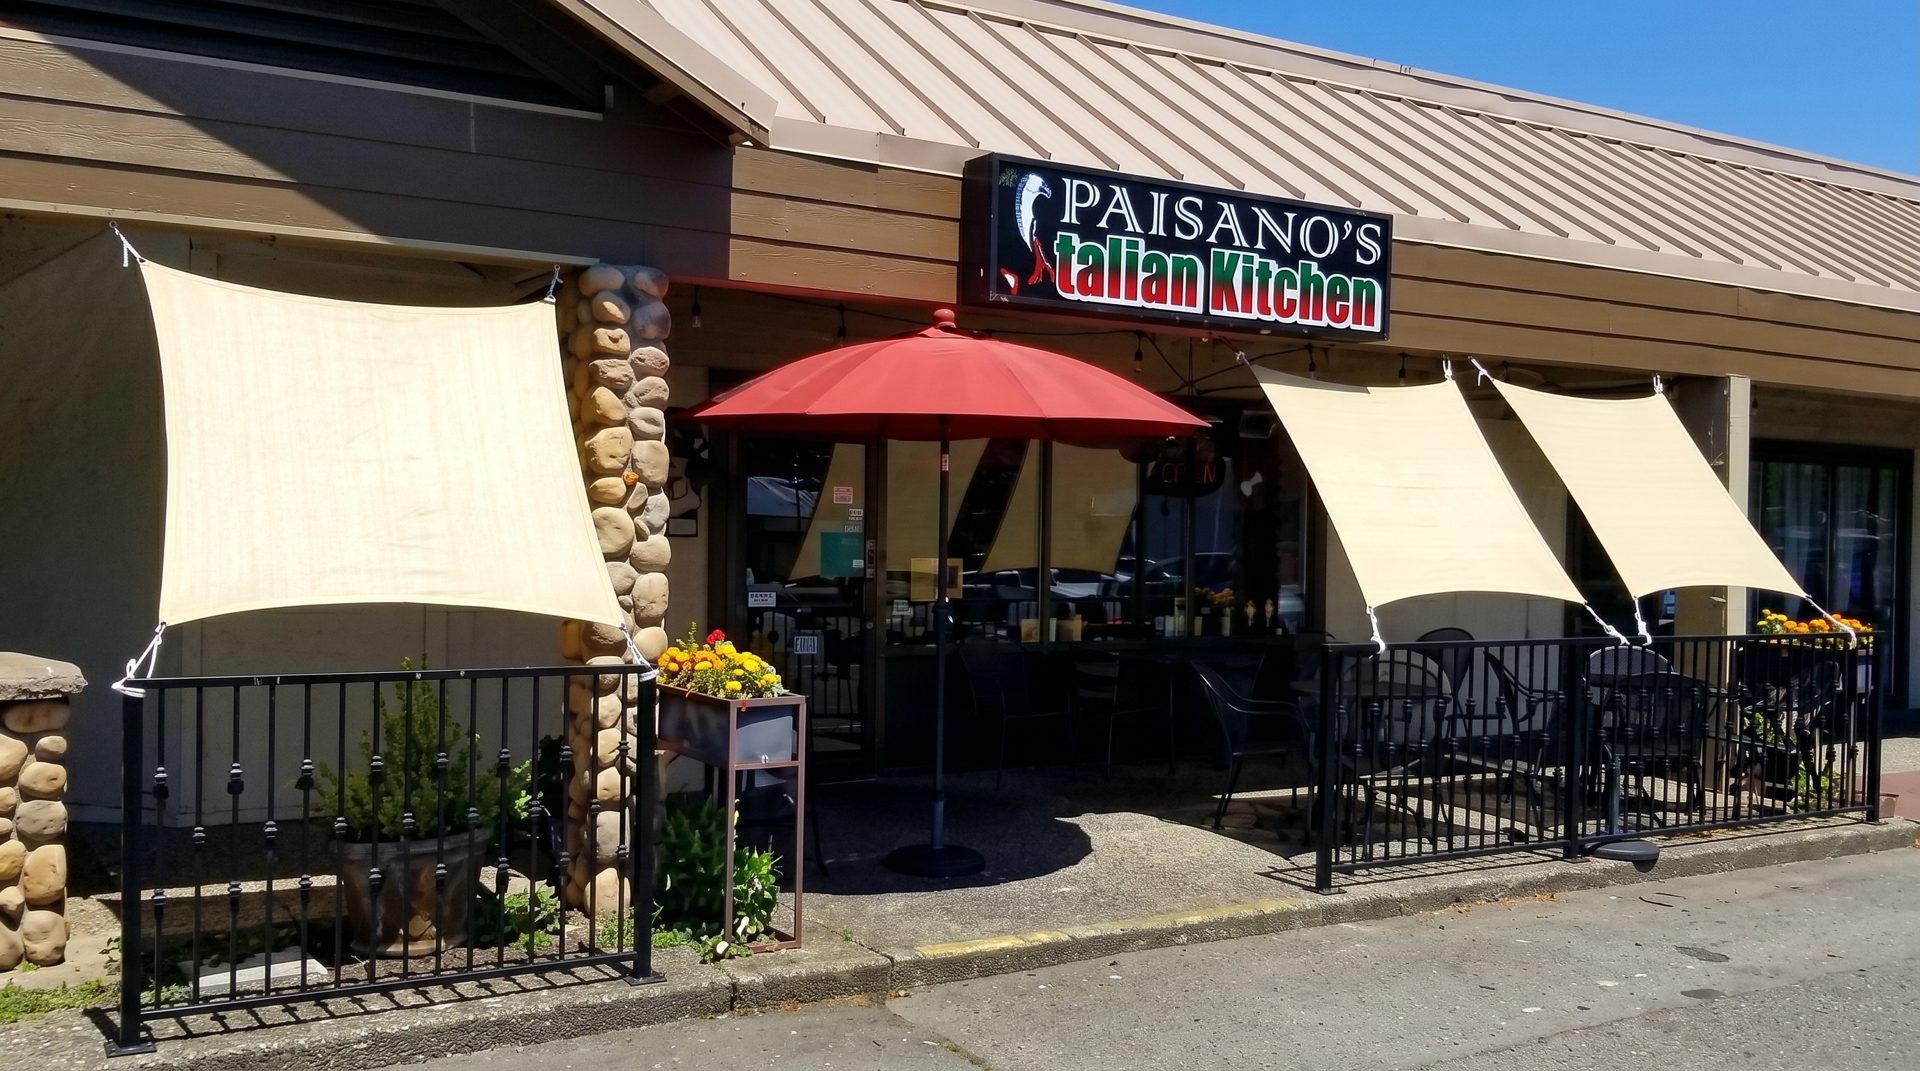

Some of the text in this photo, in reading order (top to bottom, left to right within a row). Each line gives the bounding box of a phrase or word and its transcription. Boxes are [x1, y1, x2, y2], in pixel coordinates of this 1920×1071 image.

[1059, 177, 1382, 266] PAISANO'S
[1210, 248, 1382, 332] Kitchen
[1162, 462, 1217, 485] OPN
